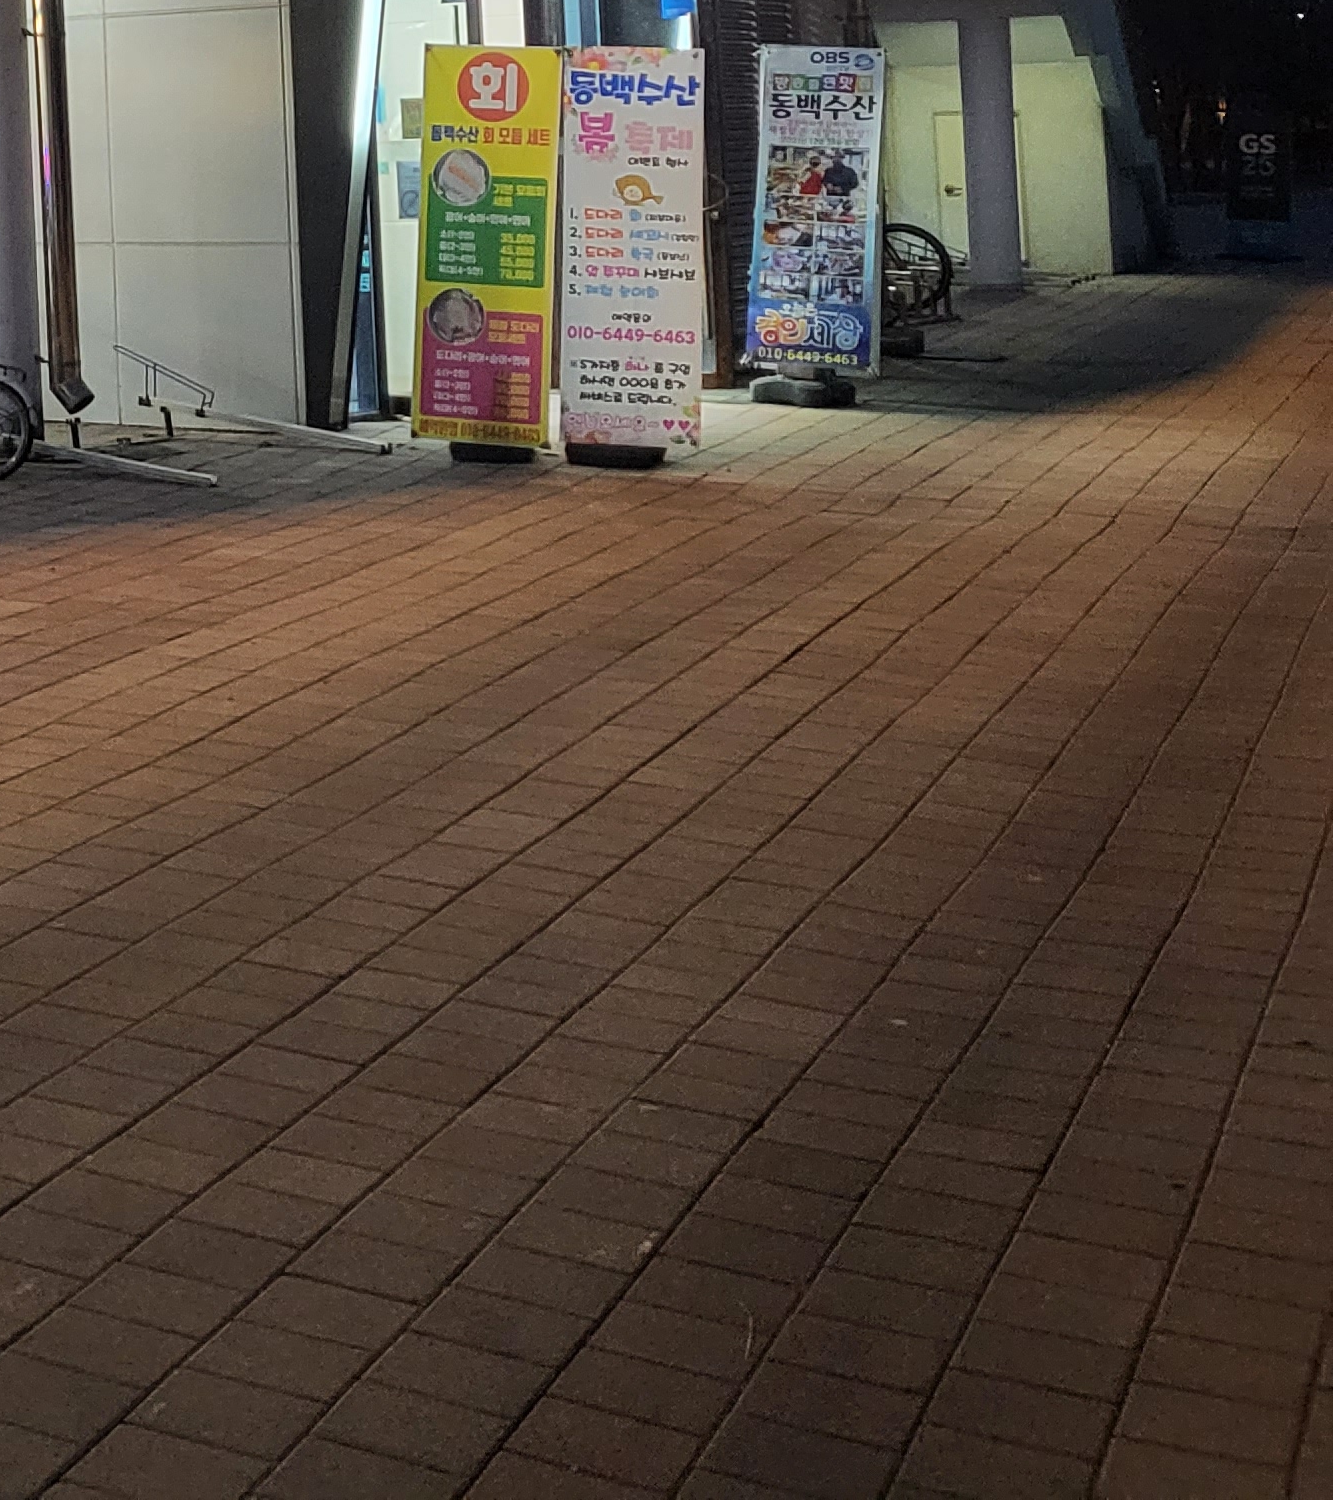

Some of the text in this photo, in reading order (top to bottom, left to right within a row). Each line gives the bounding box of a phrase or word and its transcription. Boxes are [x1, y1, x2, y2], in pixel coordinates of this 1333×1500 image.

[810, 51, 850, 64] OBS
[469, 61, 518, 112] 회
[570, 70, 701, 106] 동백수산
[769, 93, 878, 120] 동백수산
[578, 111, 615, 154] 봄
[1239, 133, 1276, 155] GS
[584, 207, 623, 220] 도다리
[569, 226, 582, 239] 2.
[585, 226, 624, 239] 도다리
[568, 245, 582, 258] 3.
[585, 245, 624, 258] 도다리
[568, 264, 582, 277] 4.
[568, 283, 581, 296] 5.
[567, 326, 696, 344] 010-6449-6463
[758, 346, 858, 365] 010-6449-6463
